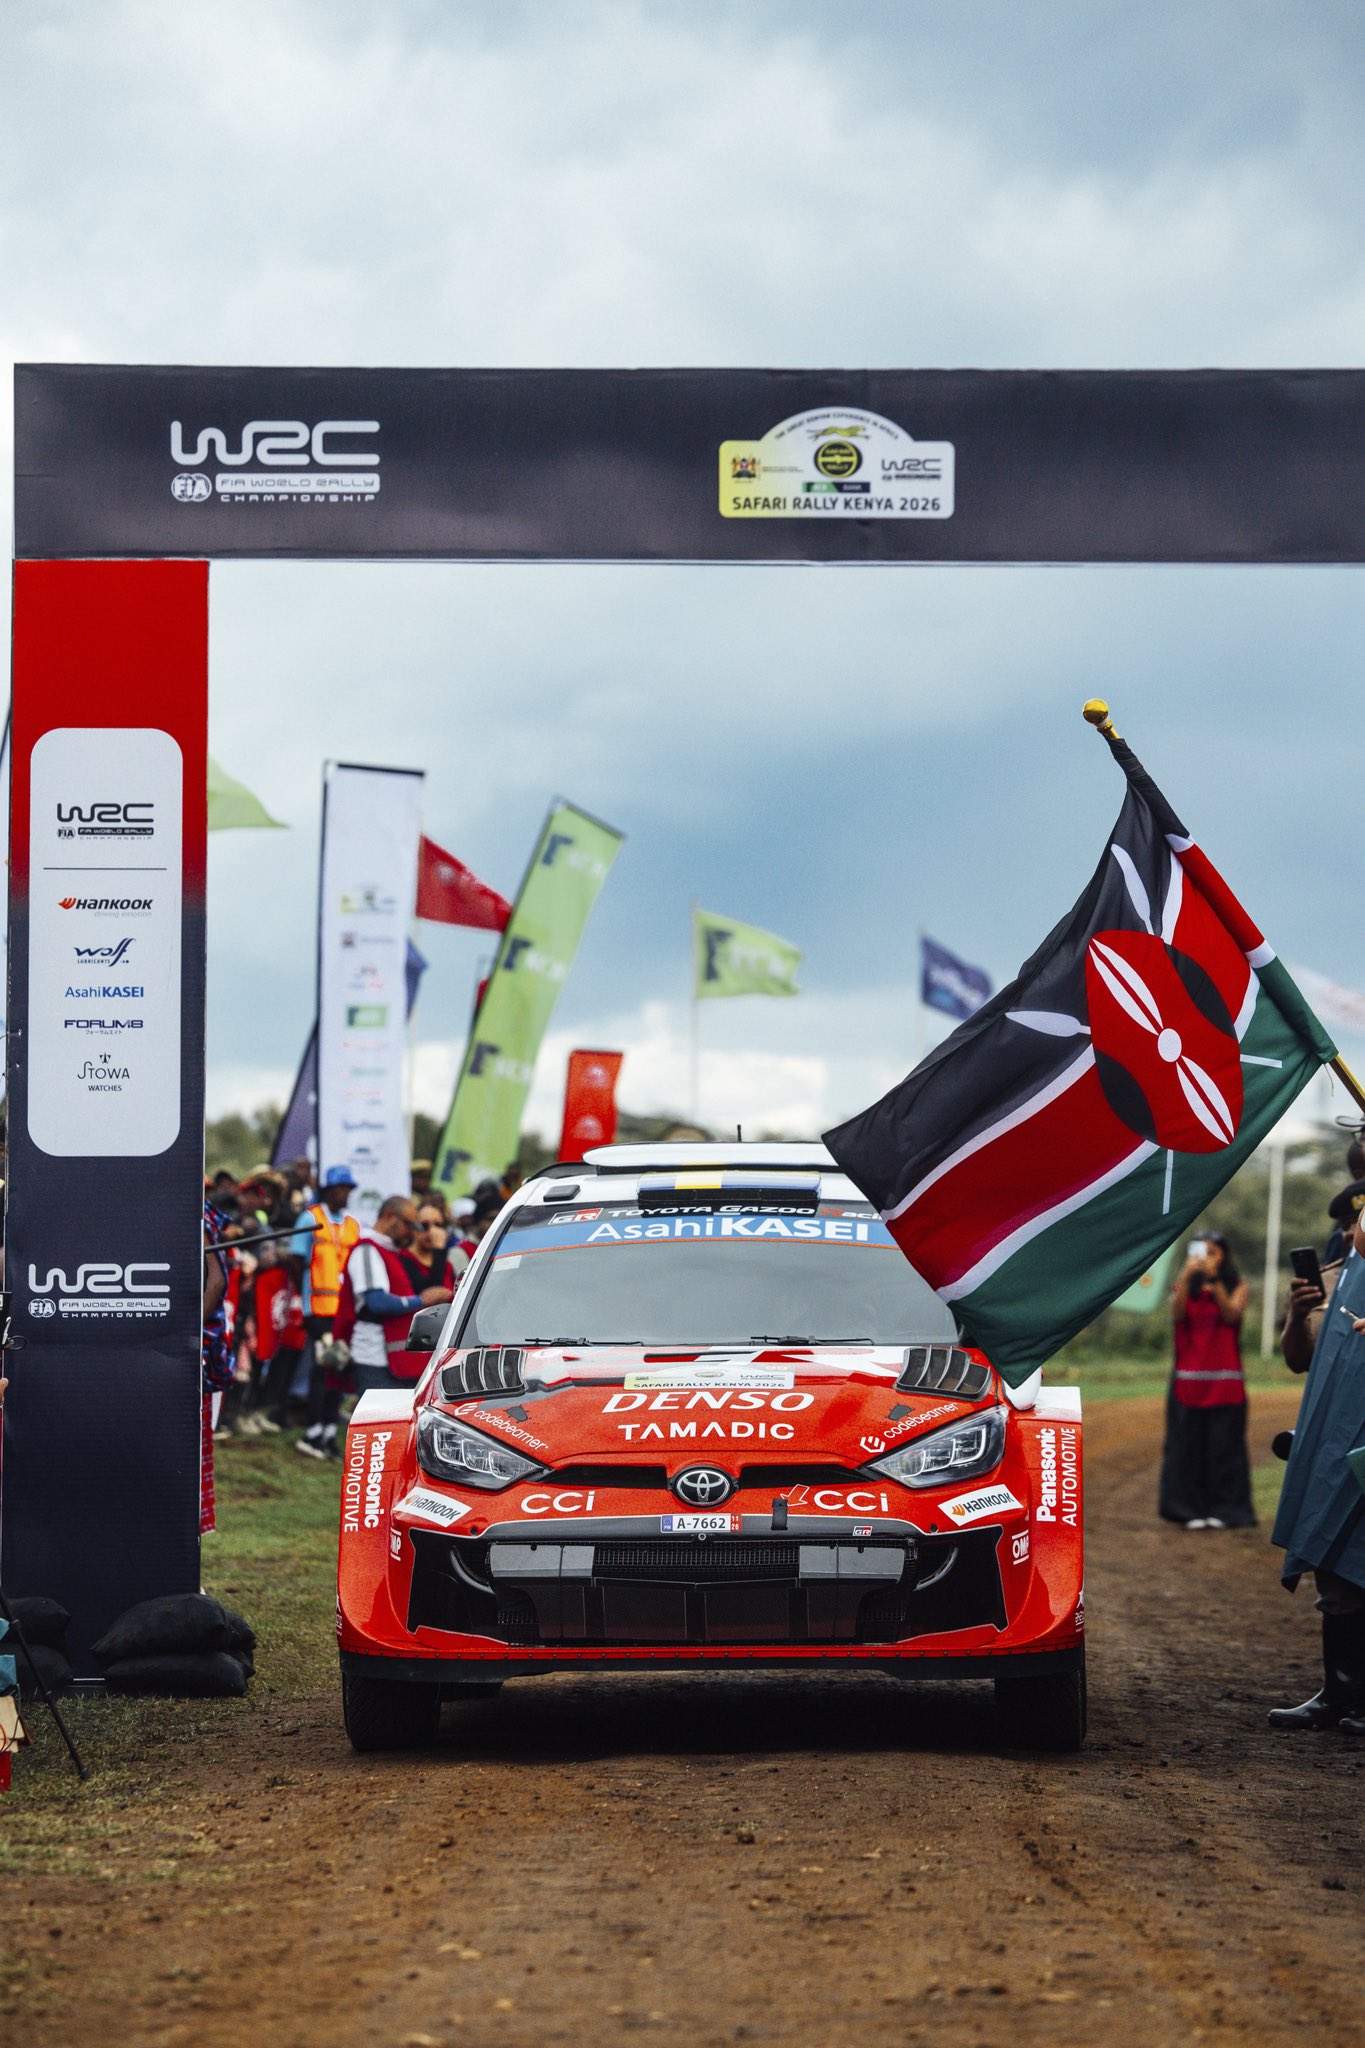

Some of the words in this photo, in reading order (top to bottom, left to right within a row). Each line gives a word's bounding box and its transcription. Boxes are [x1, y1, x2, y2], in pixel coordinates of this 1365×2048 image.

[170, 420, 380, 466] WRC
[881, 458, 942, 472] WRC
[173, 479, 210, 498] FIA
[220, 478, 246, 488] FIA
[250, 478, 311, 488] WORLD
[316, 478, 375, 488] RALLY
[220, 494, 376, 503] CHAMPIONSHIP
[732, 497, 787, 511] SAFARI
[792, 497, 837, 511] RALLY
[843, 498, 894, 511] KENYA
[899, 498, 941, 512] 2026
[57, 803, 154, 823] WRC
[57, 828, 75, 838] FIA
[64, 1019, 144, 1029] FORUM8
[77, 1061, 130, 1080] STOWA
[551, 1210, 598, 1224] GR
[607, 1206, 712, 1218] TOYOTA
[719, 1205, 816, 1215] GAZOO
[29, 1263, 171, 1293] WRC
[30, 1302, 55, 1314] FIA
[602, 1391, 815, 1414] DENSO
[883, 1402, 958, 1439] codebeamer
[473, 1410, 546, 1450] codebeamer
[617, 1422, 795, 1440] TAMADIC
[344, 1433, 367, 1533] AUTOMOTIVE
[364, 1431, 392, 1529] Panasonic
[1035, 1427, 1057, 1523] Panasonic
[1060, 1427, 1078, 1527] AUTOMOTIVE
[676, 1517, 726, 1529] A-7662
[731, 1523, 739, 1531] 26
